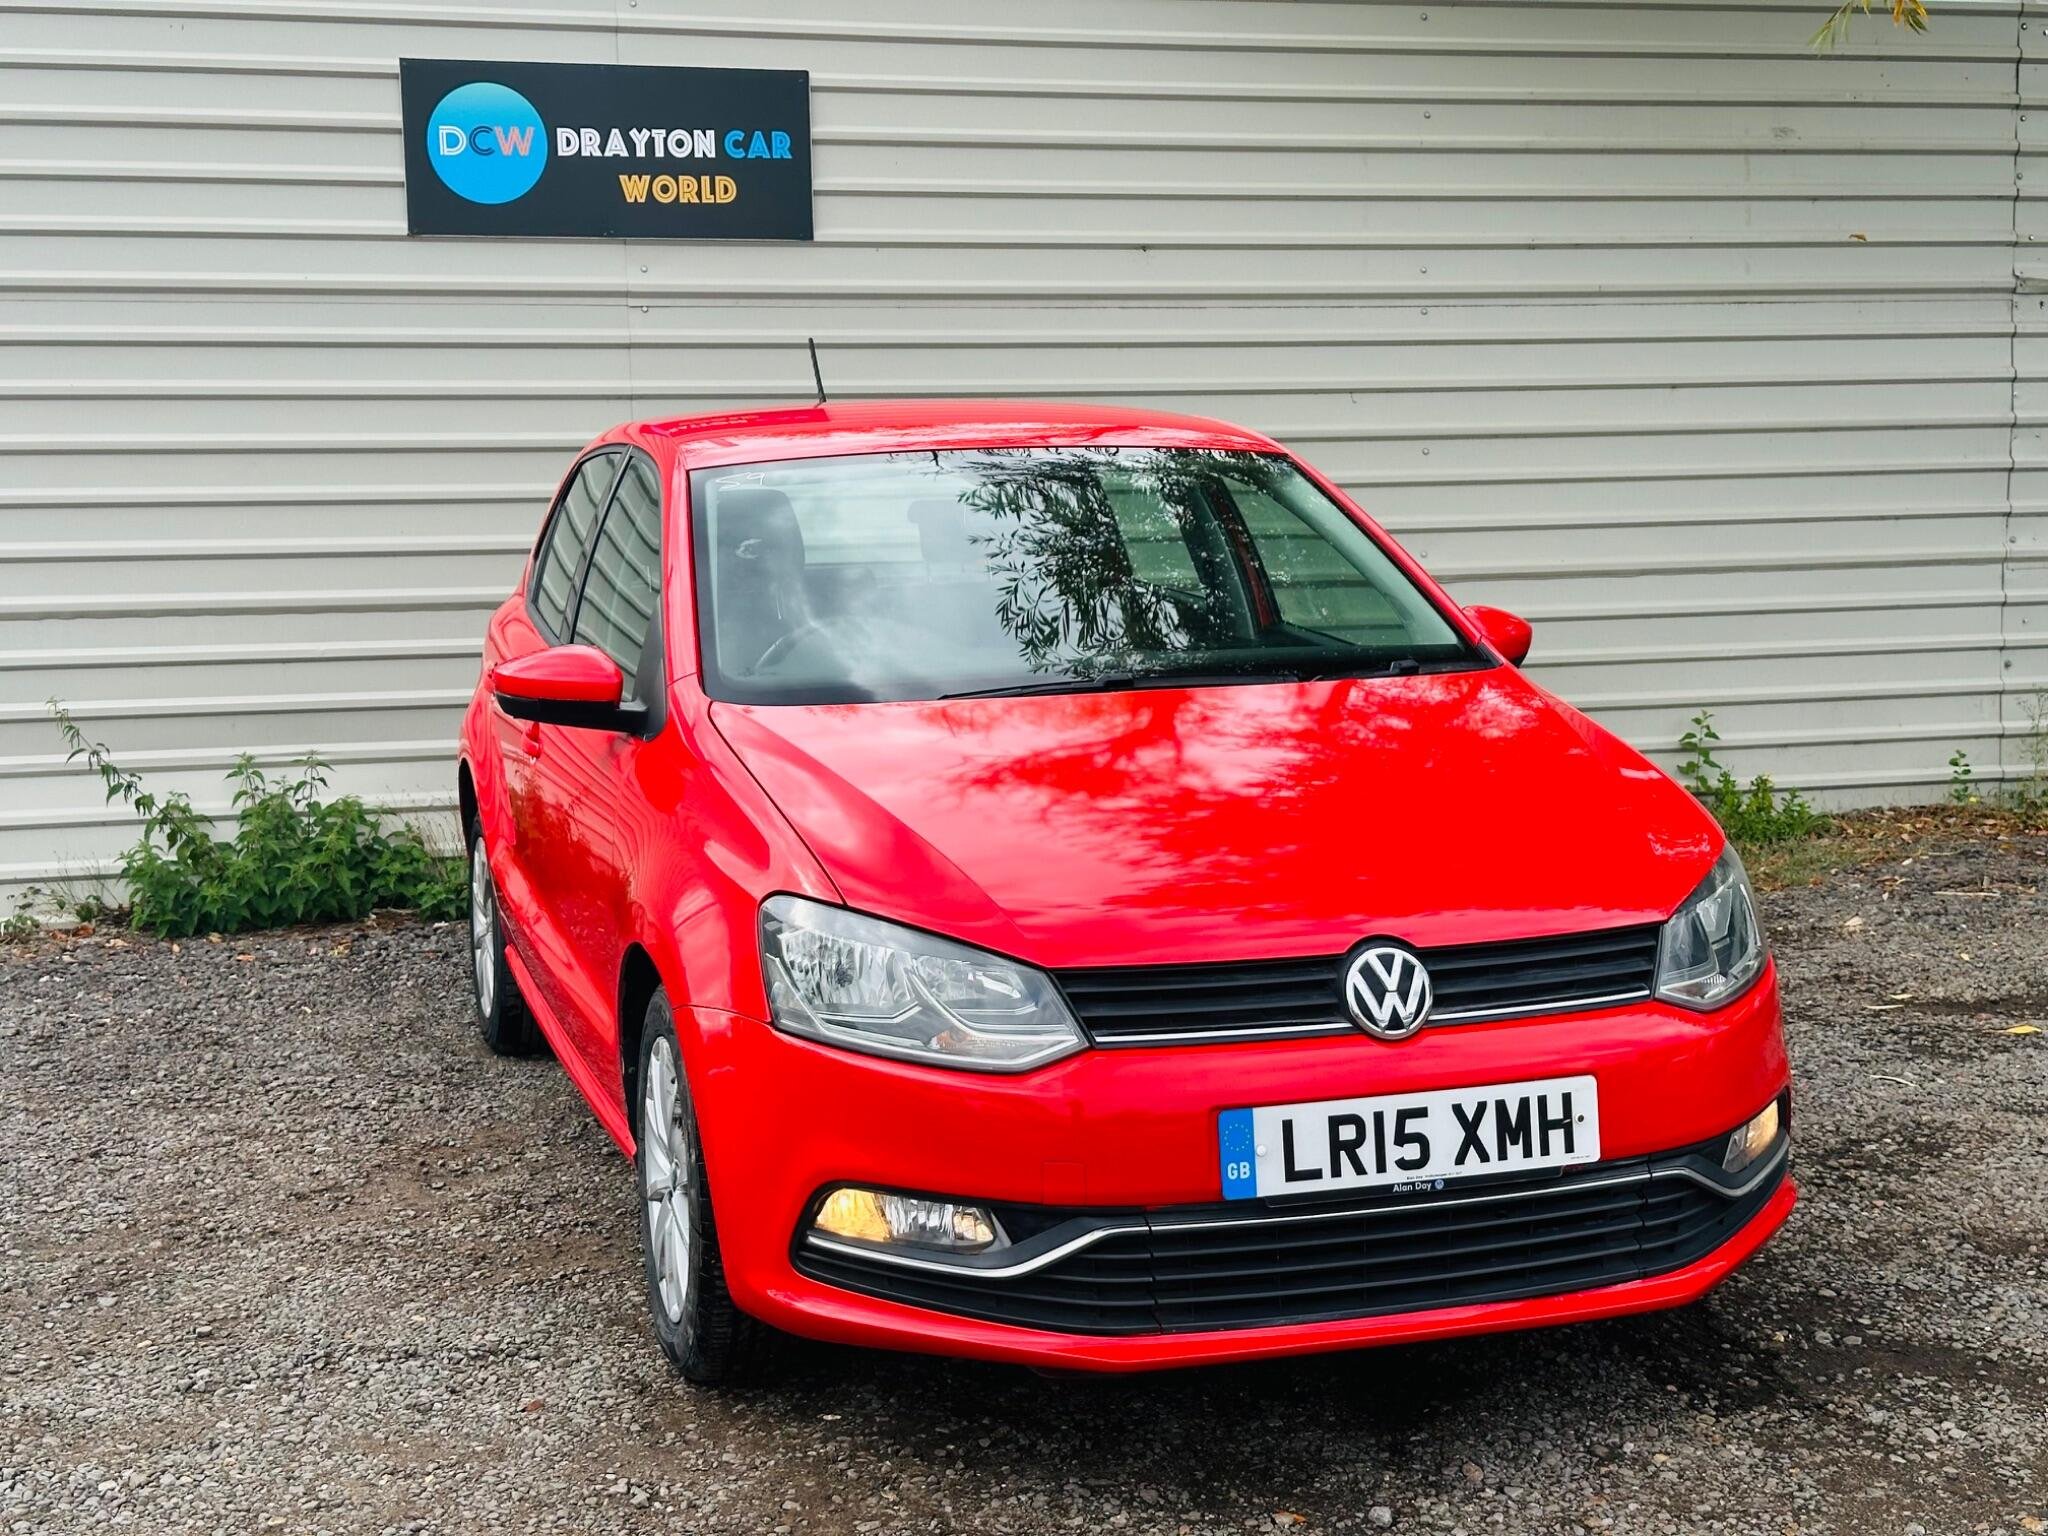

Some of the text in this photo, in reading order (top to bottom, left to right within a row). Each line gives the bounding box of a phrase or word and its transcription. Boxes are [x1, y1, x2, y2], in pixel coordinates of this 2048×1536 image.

[438, 125, 535, 157] DCW
[556, 127, 793, 160] DRAYTON CAR
[618, 174, 737, 204] WORLD
[1347, 948, 1430, 1035] VW
[1281, 1091, 1576, 1183] LR15 XMH
[1227, 1161, 1251, 1180] GB
[1392, 1181, 1432, 1193] Alan Day
